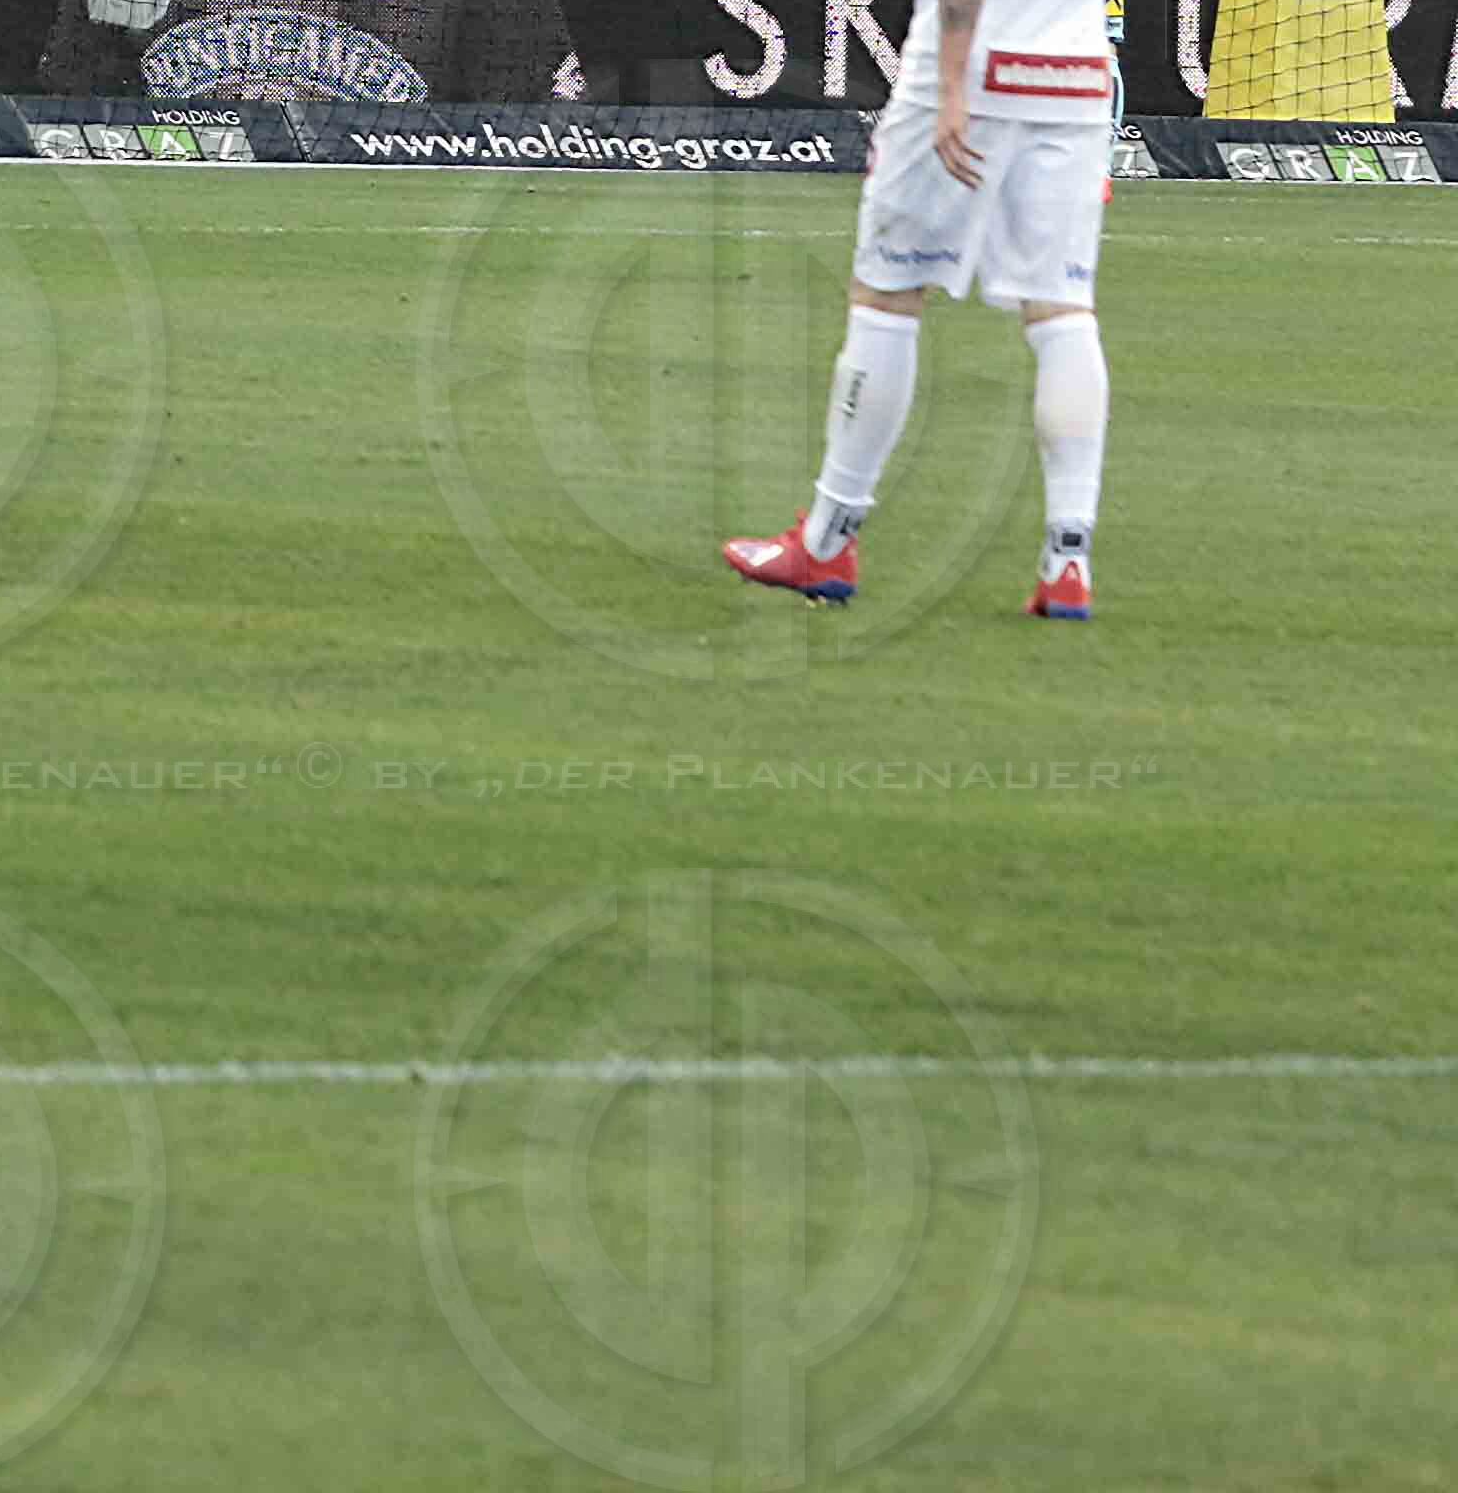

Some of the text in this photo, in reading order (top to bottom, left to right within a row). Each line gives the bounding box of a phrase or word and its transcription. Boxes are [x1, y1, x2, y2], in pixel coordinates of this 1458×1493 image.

[152, 106, 241, 128] HOLDING
[350, 125, 834, 168] www.holding-graz.at
[1337, 129, 1423, 146] HOLDING
[1228, 144, 1420, 181] GRAZ
